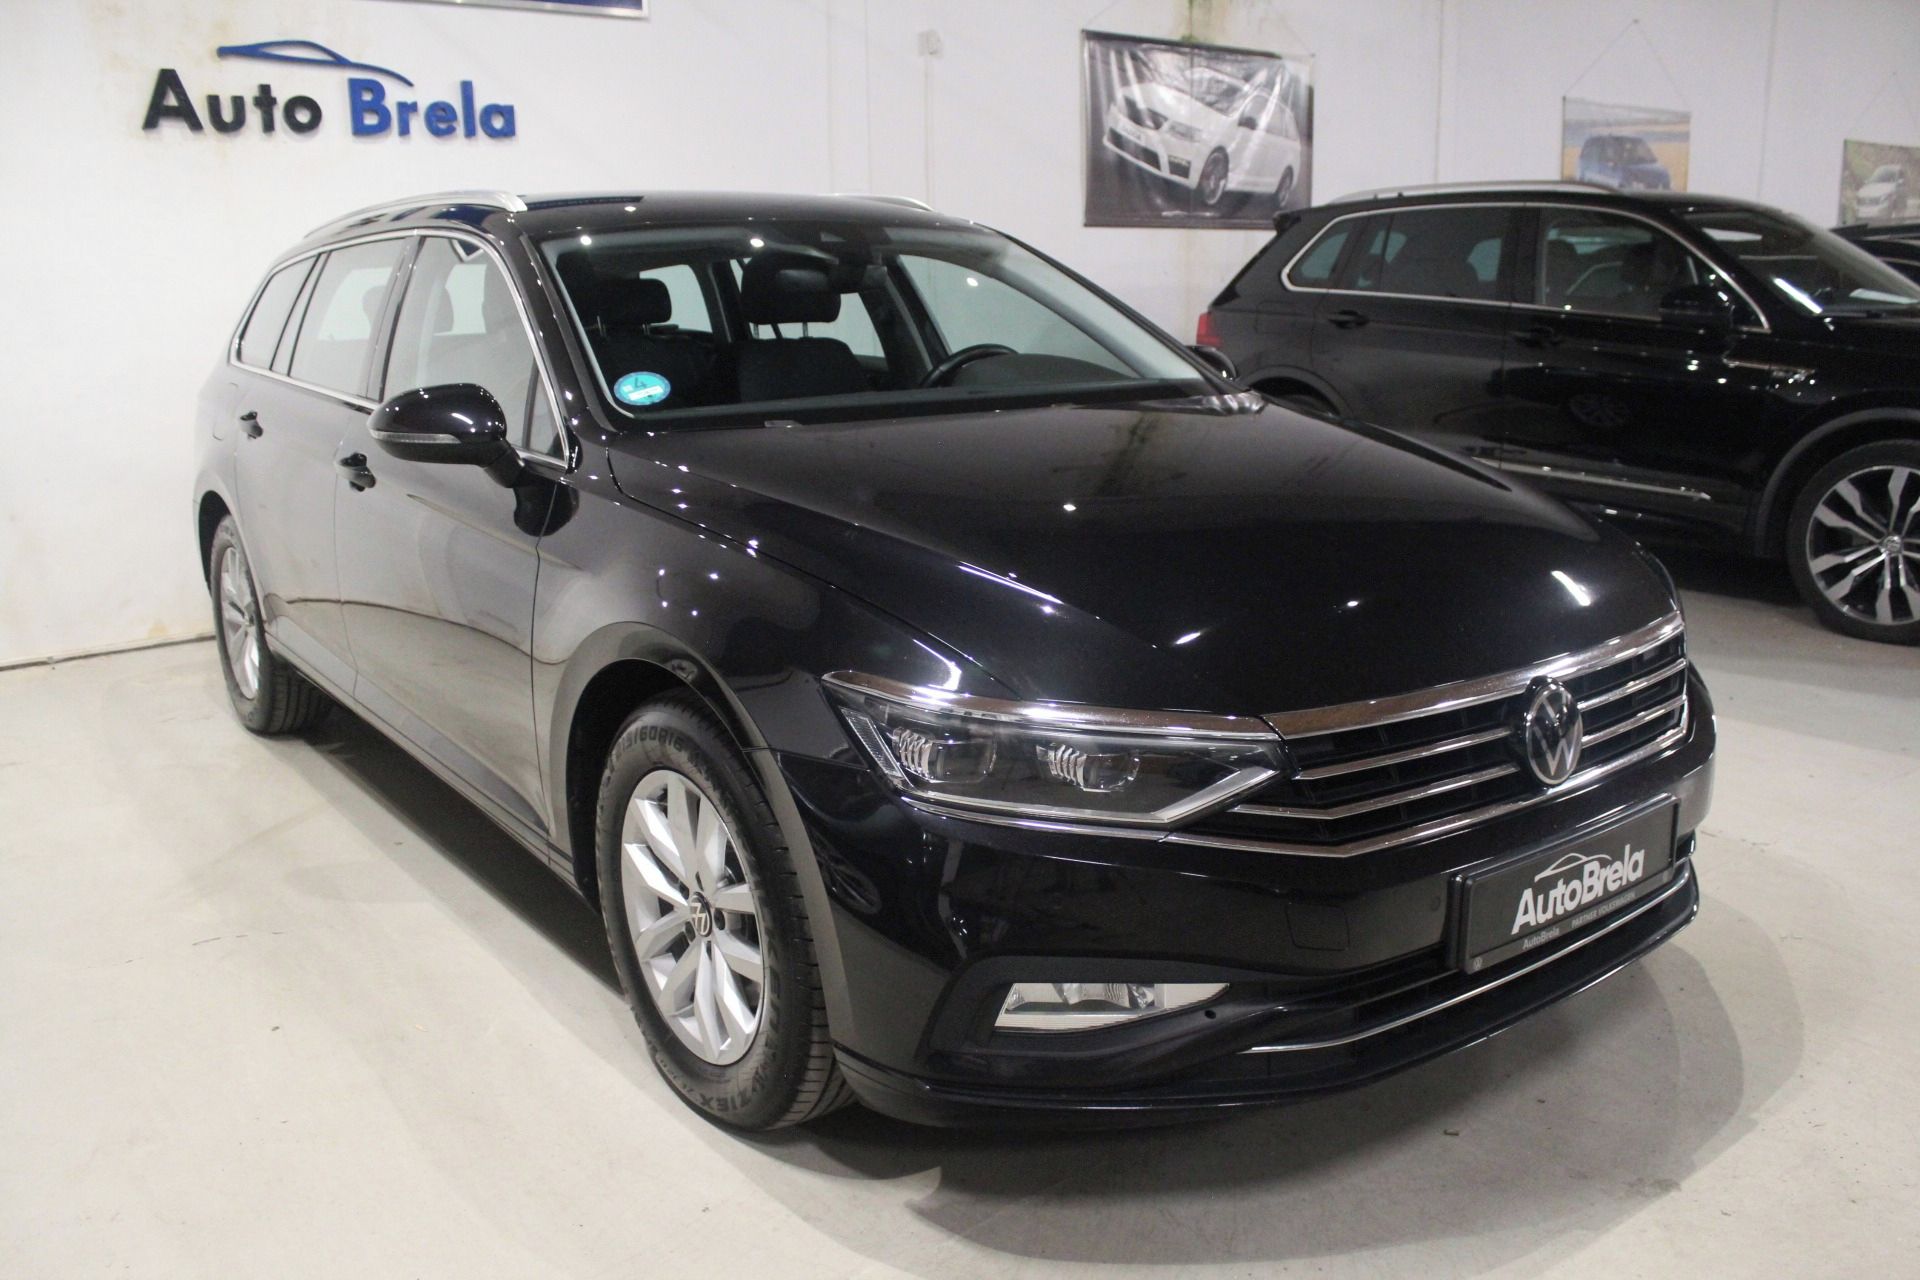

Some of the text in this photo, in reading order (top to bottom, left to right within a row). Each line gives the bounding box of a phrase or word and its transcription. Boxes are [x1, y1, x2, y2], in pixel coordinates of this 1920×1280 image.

[142, 67, 517, 139] Auto Brela
[1510, 843, 1645, 935] AutoBrela
